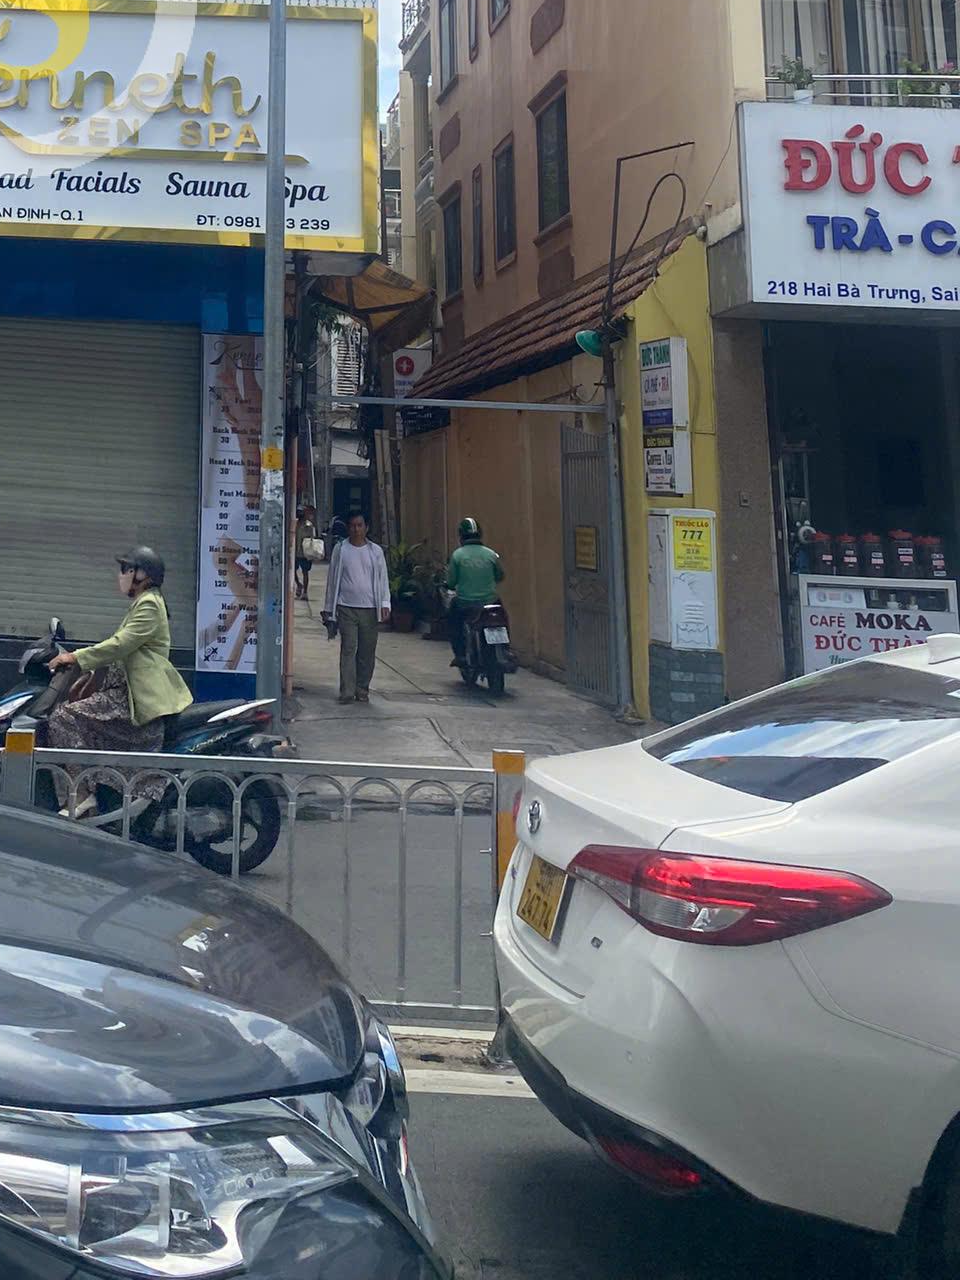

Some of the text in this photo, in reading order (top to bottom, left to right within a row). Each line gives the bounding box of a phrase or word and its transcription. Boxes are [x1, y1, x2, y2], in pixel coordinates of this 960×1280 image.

[57, 114, 261, 151] ZEN SPA
[781, 123, 933, 196] ĐỨC
[51, 167, 141, 195] Facials
[166, 171, 251, 199] Sauna
[196, 214, 220, 227] ĐT:
[224, 215, 261, 228] 0981
[300, 218, 330, 230] 239
[767, 280, 798, 296] 218
[803, 282, 831, 298] Hai
[837, 282, 861, 299] Bà
[867, 284, 926, 304] Trưng,
[682, 530, 703, 540] 777
[810, 612, 933, 631] CAFÉ MOKA
[815, 630, 862, 652] ĐỨC
